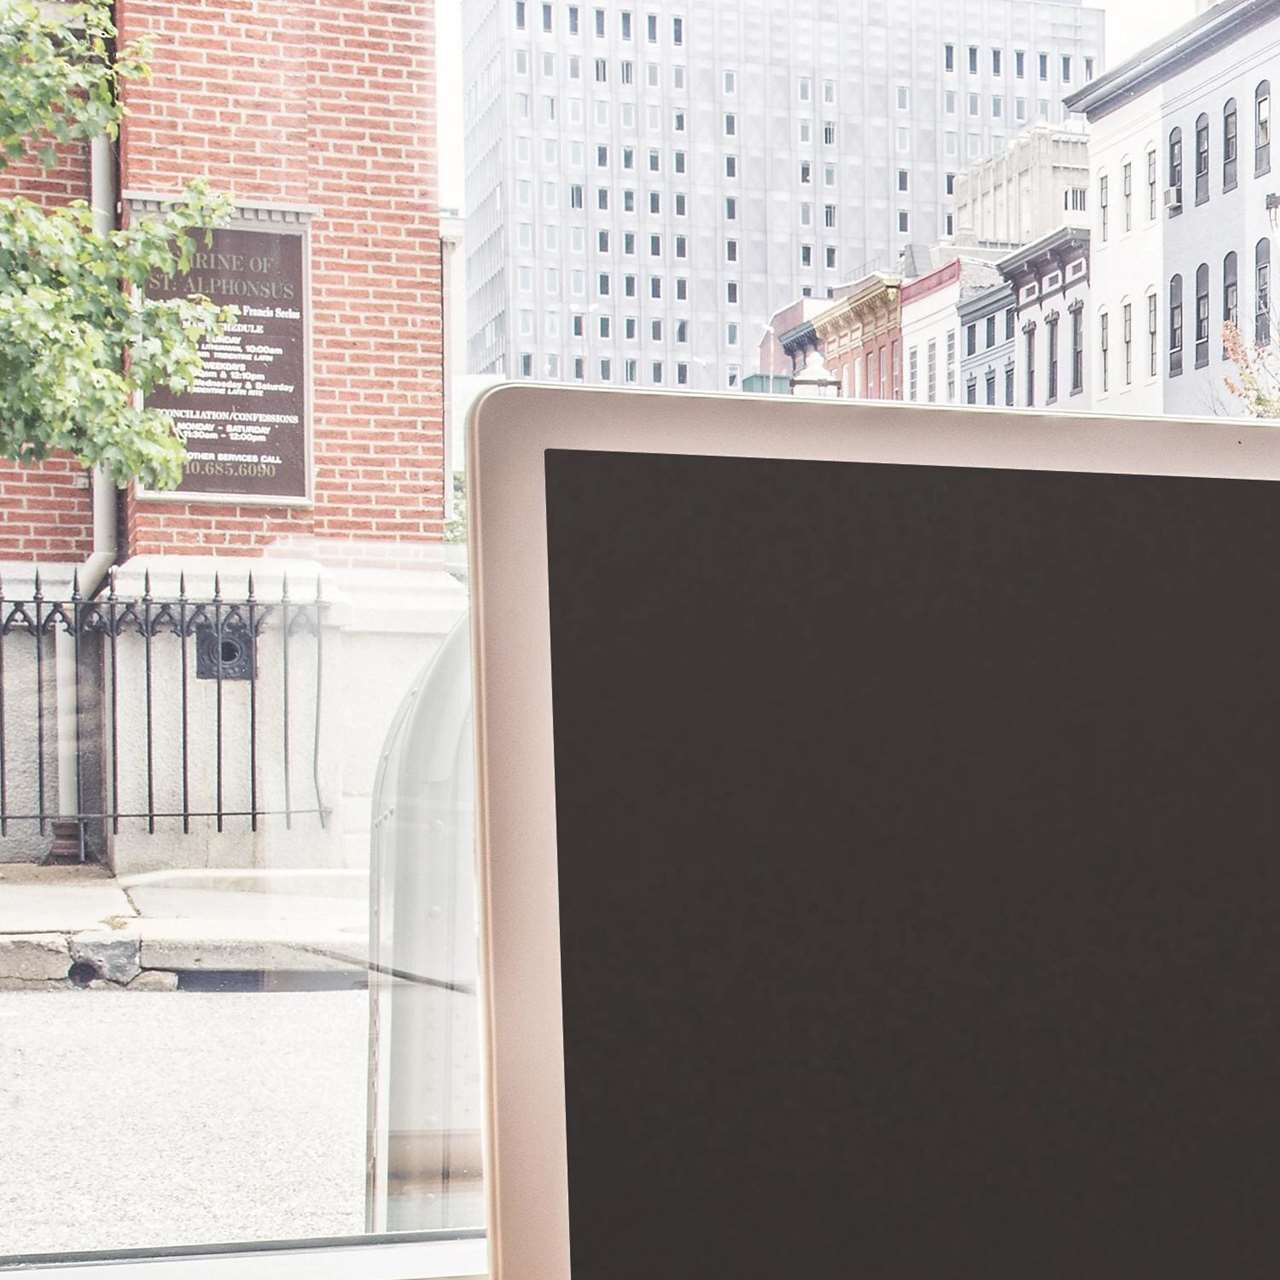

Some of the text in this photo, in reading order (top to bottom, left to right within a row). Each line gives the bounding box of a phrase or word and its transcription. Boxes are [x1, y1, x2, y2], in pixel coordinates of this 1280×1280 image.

[249, 256, 273, 273] OF
[183, 275, 295, 300] ALPHONSUS
[255, 381, 295, 393] Saturday
[158, 408, 299, 424] CONCILIATION/CONFESSIONS
[177, 422, 215, 431] MONDAY
[226, 424, 271, 435] SATURDAY
[186, 452, 283, 464] OTHER SERVICES CALL
[184, 460, 276, 477] 10.685.6090
